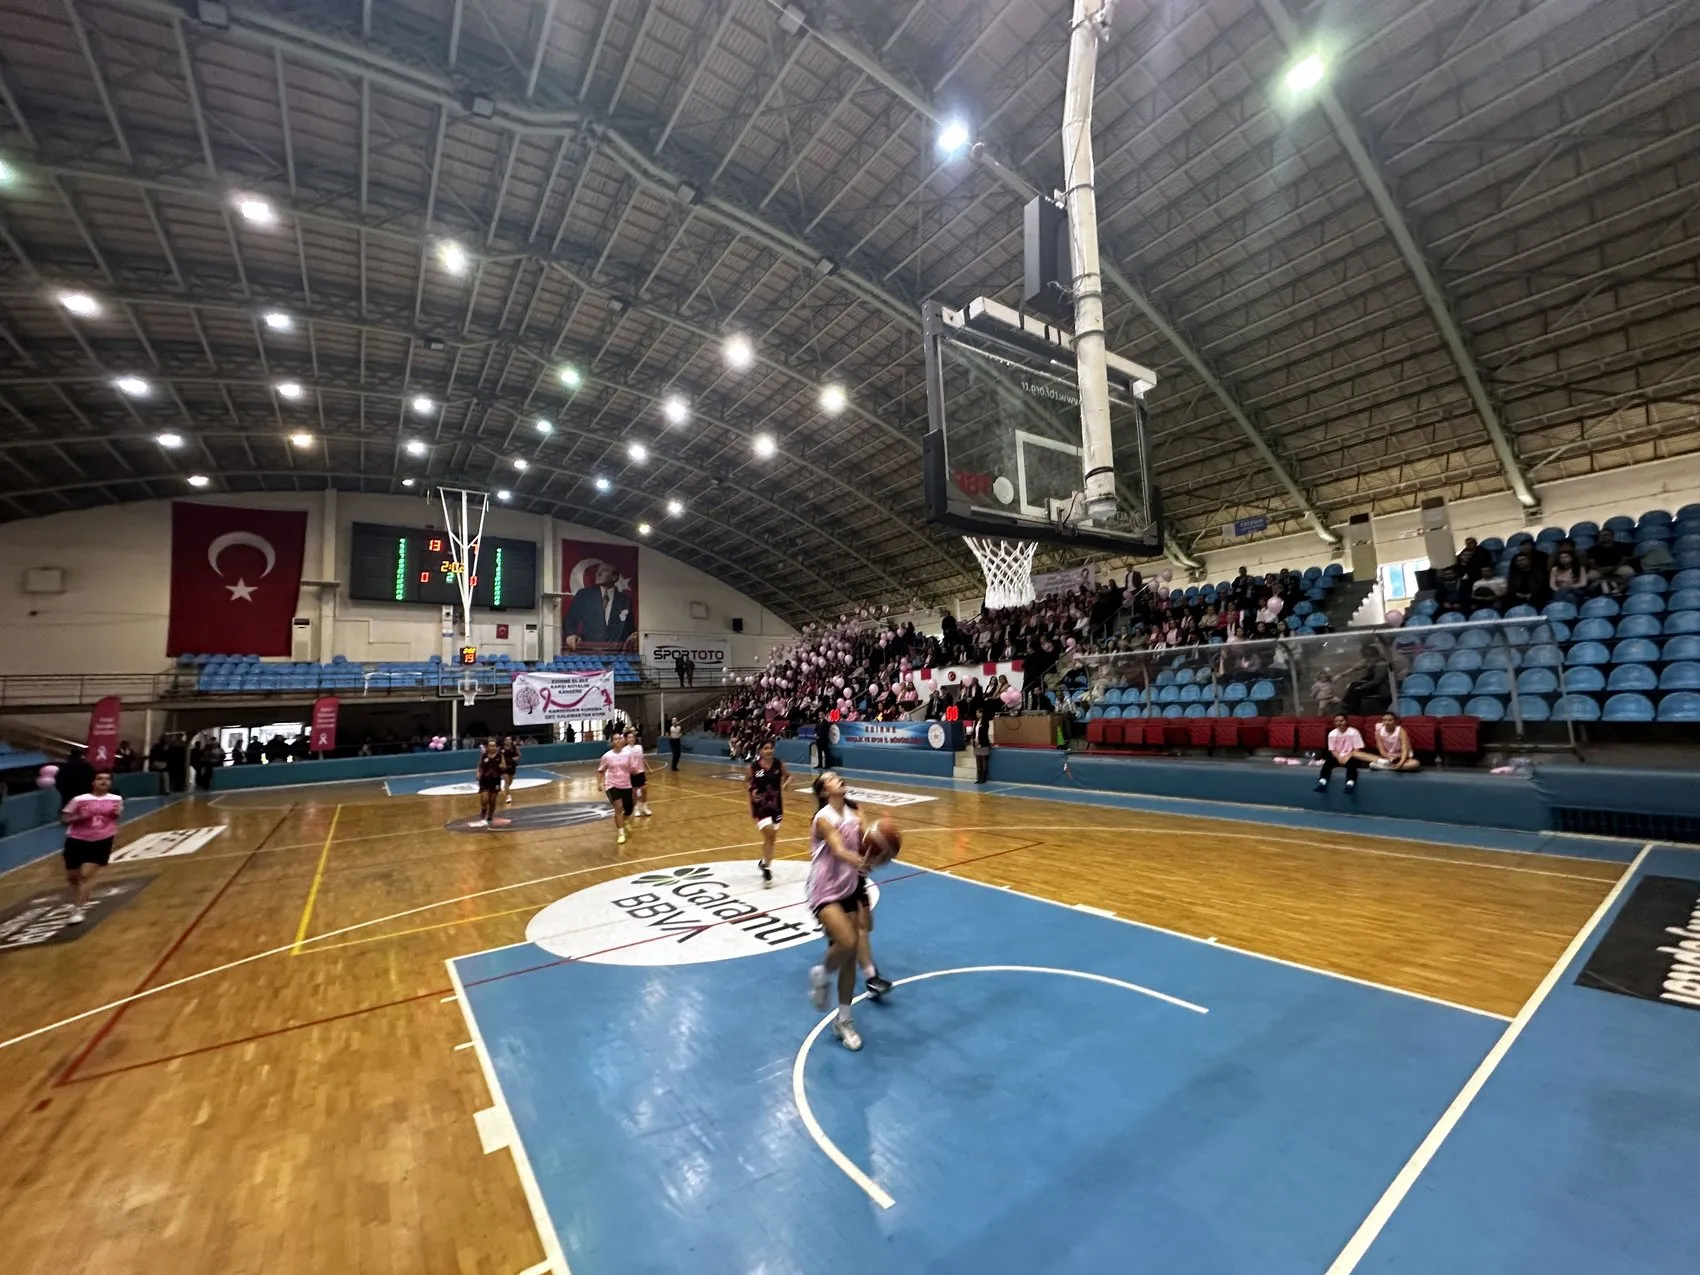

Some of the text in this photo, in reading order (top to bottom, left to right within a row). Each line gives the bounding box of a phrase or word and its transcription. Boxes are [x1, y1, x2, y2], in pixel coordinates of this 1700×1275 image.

[429, 540, 441, 551] 13
[420, 572, 429, 582] 0
[446, 572, 454, 583] 2
[470, 576, 477, 586] 0
[612, 892, 711, 944] BBVA
[672, 881, 824, 946] Garanti
